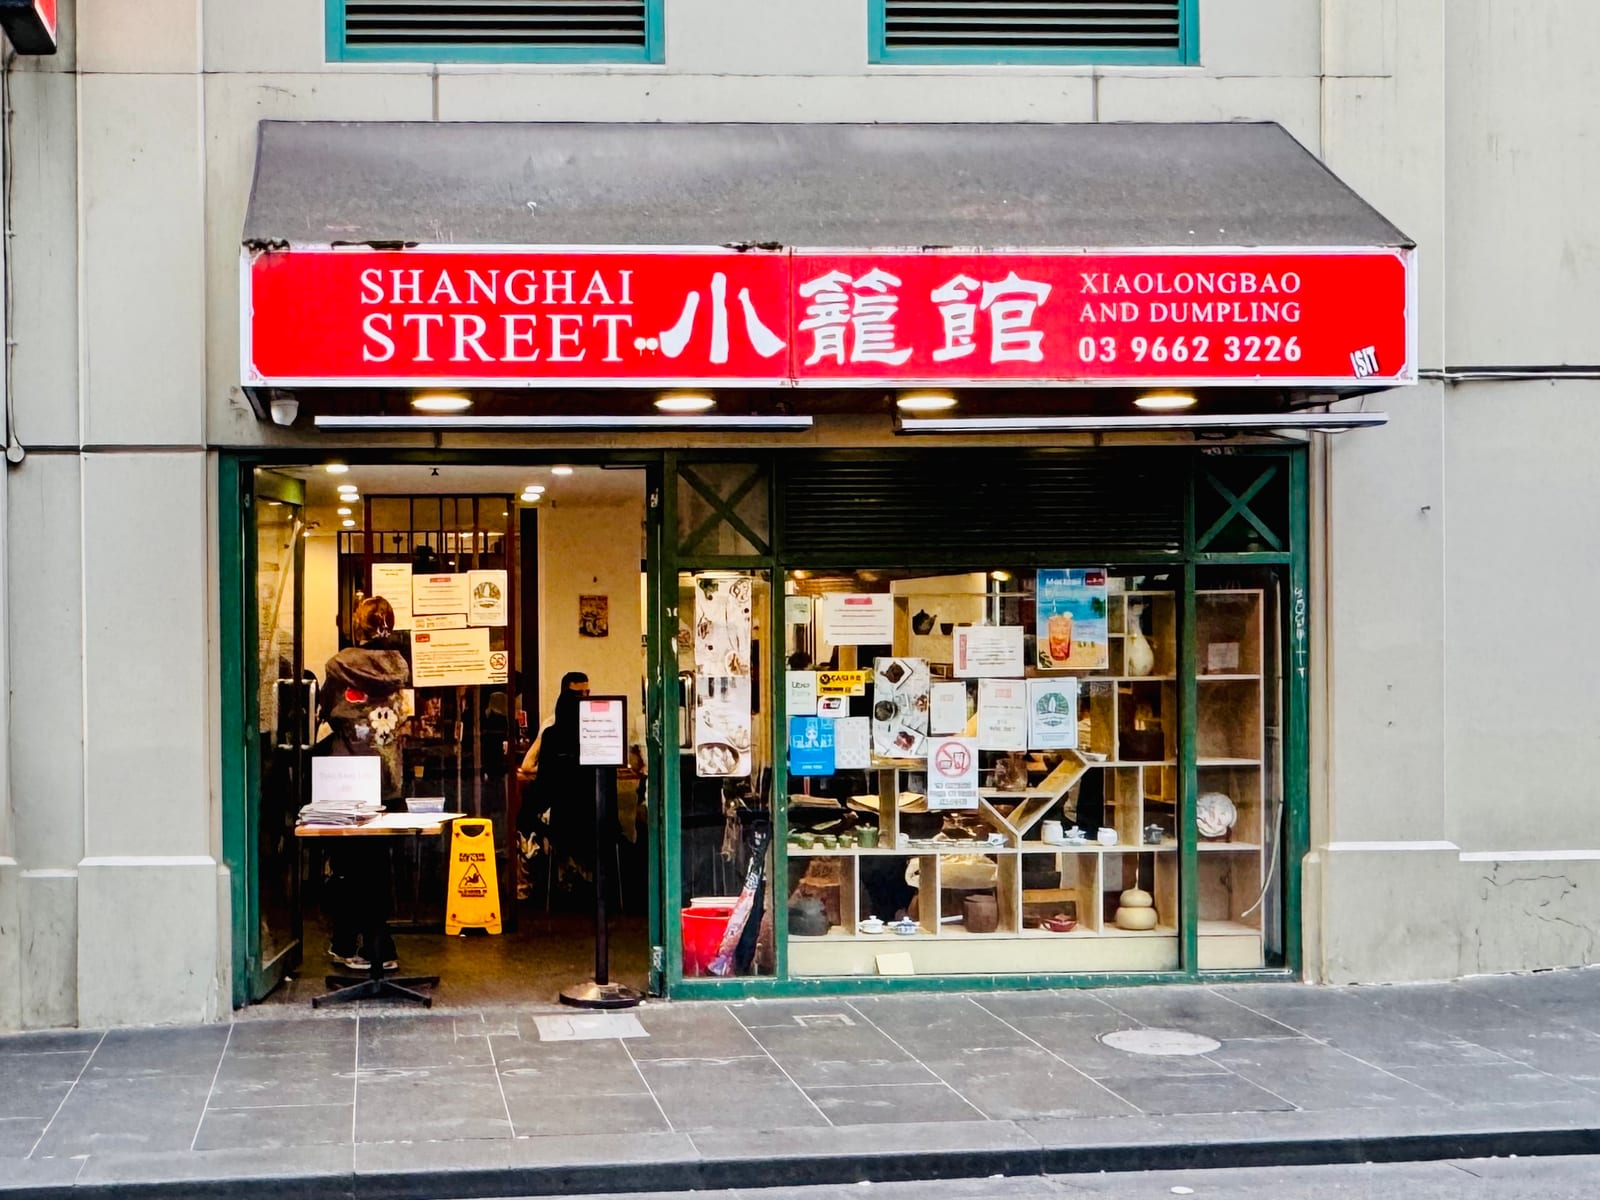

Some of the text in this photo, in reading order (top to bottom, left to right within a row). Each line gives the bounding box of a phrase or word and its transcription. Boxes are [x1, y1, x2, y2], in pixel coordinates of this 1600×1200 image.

[360, 268, 634, 305] SHANGHAI
[1079, 271, 1302, 294] XIAOLONGBAO
[659, 267, 1052, 366] 小籠館
[1079, 301, 1302, 323] AND DUMPLING
[362, 312, 634, 363] STREET
[1078, 335, 1302, 362] 03 9662 3226
